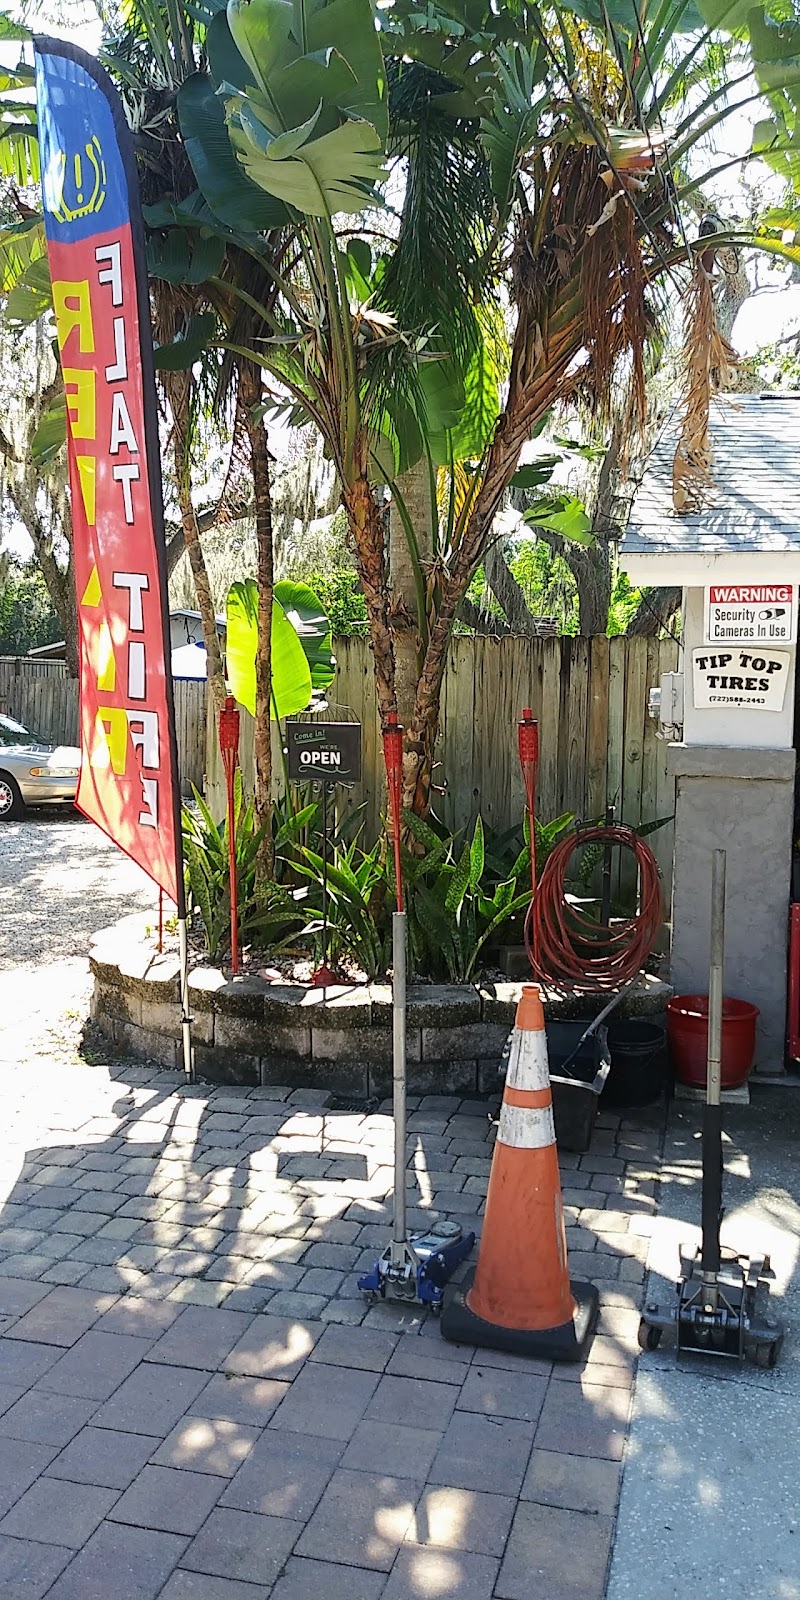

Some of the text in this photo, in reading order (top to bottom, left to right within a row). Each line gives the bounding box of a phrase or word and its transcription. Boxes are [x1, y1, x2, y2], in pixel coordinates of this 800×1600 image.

[714, 588, 789, 602] WARNING
[714, 608, 756, 623] Security
[714, 624, 786, 637] Cameras In Use
[695, 653, 783, 674] TIP TOP
[707, 675, 769, 691] TIRES
[294, 729, 326, 740] Come in!
[300, 751, 341, 765] OPEN
